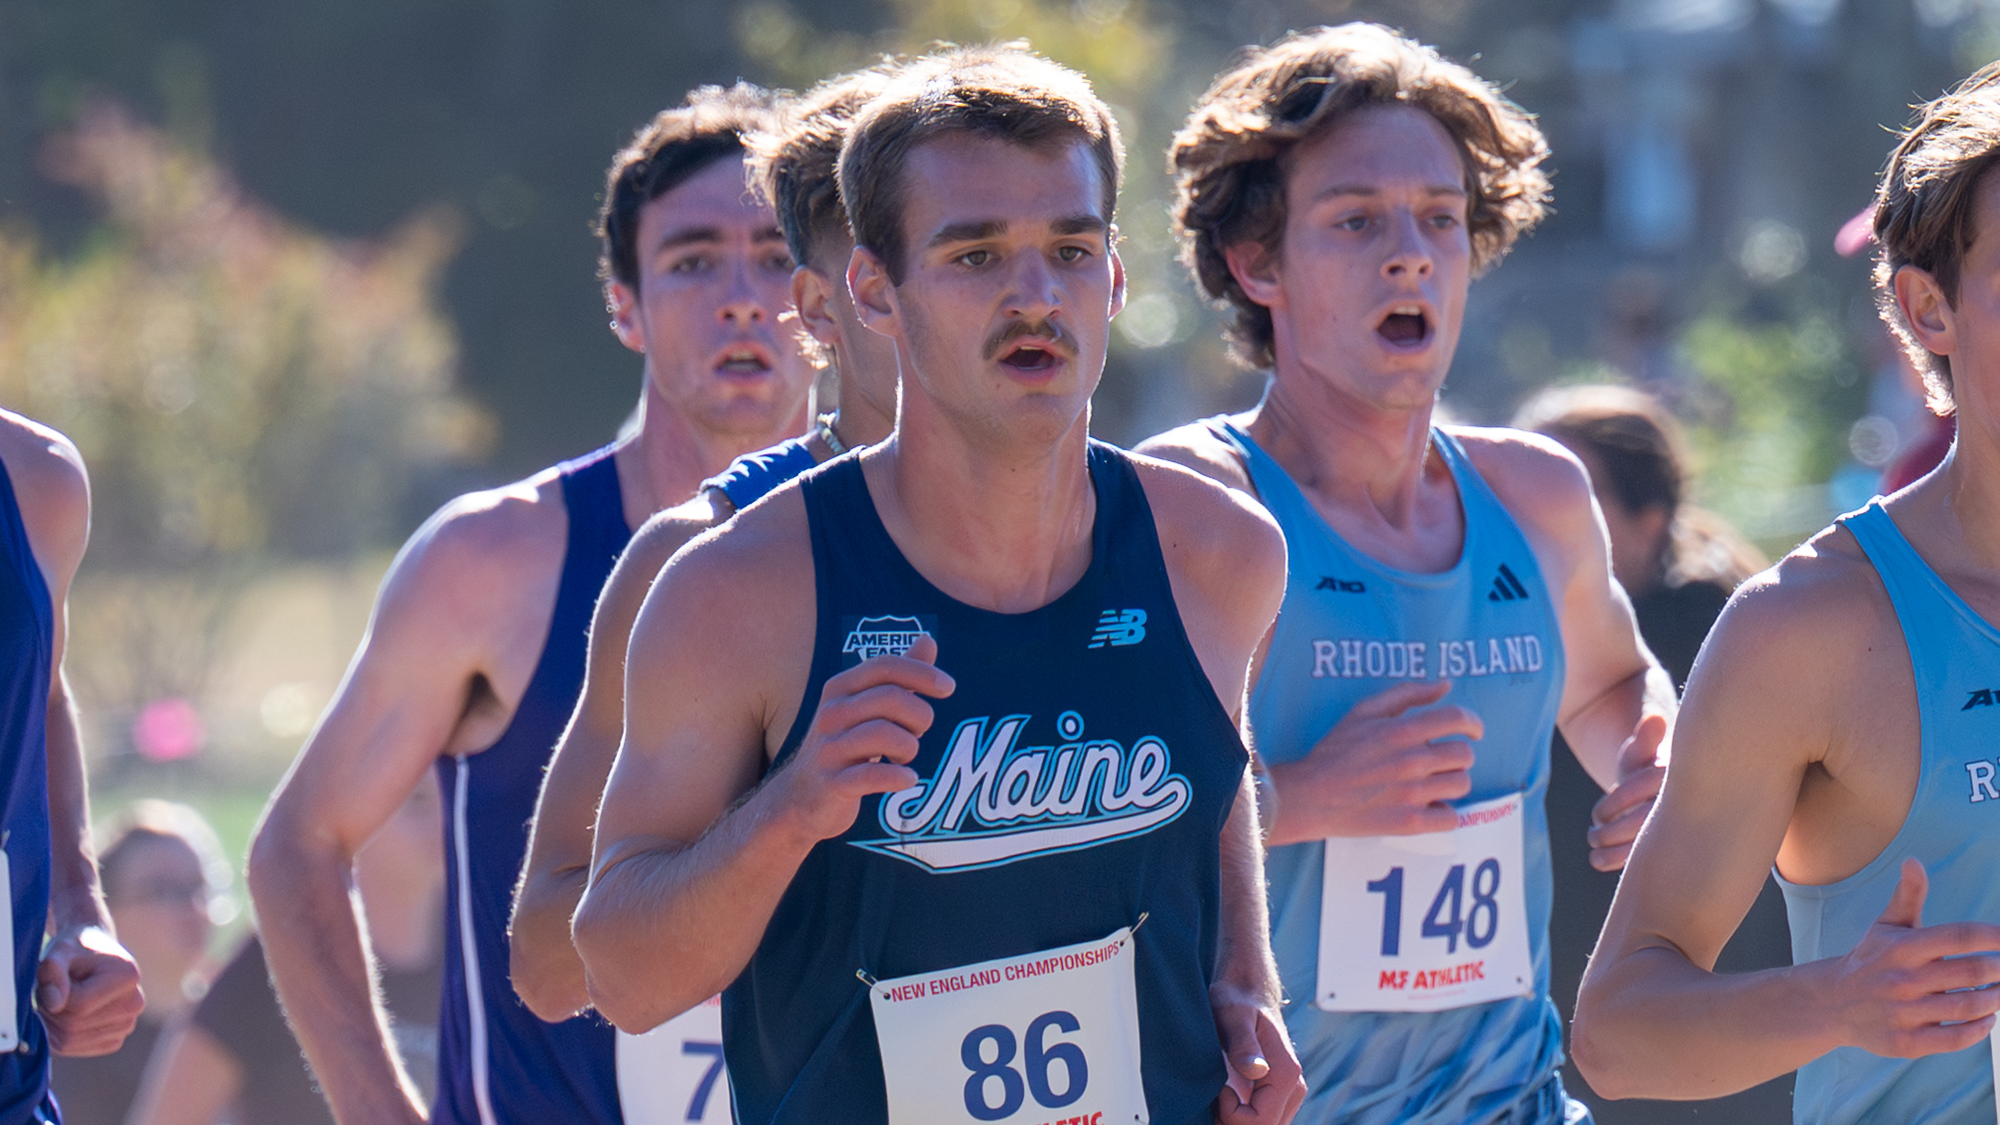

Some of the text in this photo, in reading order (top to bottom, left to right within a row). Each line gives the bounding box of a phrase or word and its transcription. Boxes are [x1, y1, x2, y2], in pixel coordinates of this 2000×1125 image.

[847, 632, 924, 650] AMERIC
[1311, 634, 1543, 679] RHODE ISLAND
[878, 711, 1192, 838] Maine
[1965, 760, 2000, 803] R
[1366, 857, 1501, 957] 148
[891, 940, 1120, 1003] NEW ENGLAND CHAMPIONSHIPS
[1412, 960, 1485, 989] ATHLETIC
[960, 1010, 1089, 1121] 86
